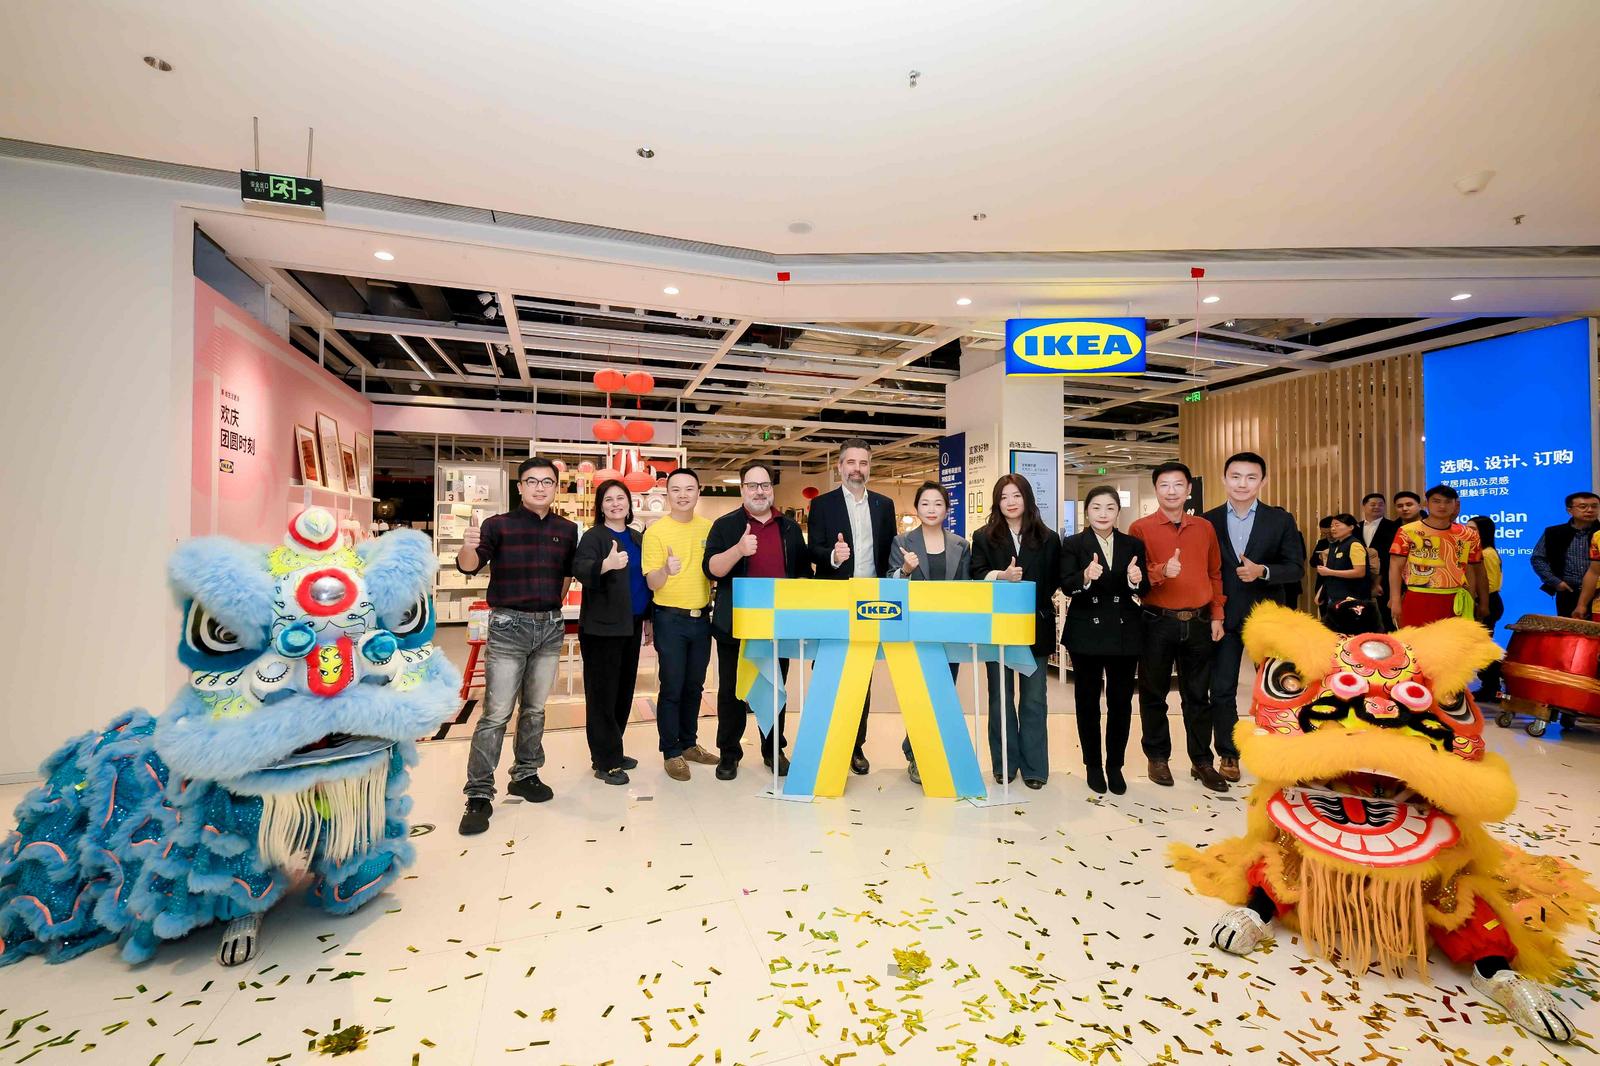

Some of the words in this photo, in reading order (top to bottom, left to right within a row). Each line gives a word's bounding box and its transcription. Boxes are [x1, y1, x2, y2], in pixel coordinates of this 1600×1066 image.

[1025, 335, 1133, 356] IKEA
[221, 405, 239, 427] 欢庆
[221, 429, 255, 455] 团圆时刻
[221, 462, 233, 470] IKEA
[1440, 450, 1573, 473] 选购、设计、订购
[1456, 487, 1509, 498] 里触手可及
[1490, 511, 1528, 524] plan
[1494, 527, 1524, 539] der
[861, 606, 898, 614] IKEA
